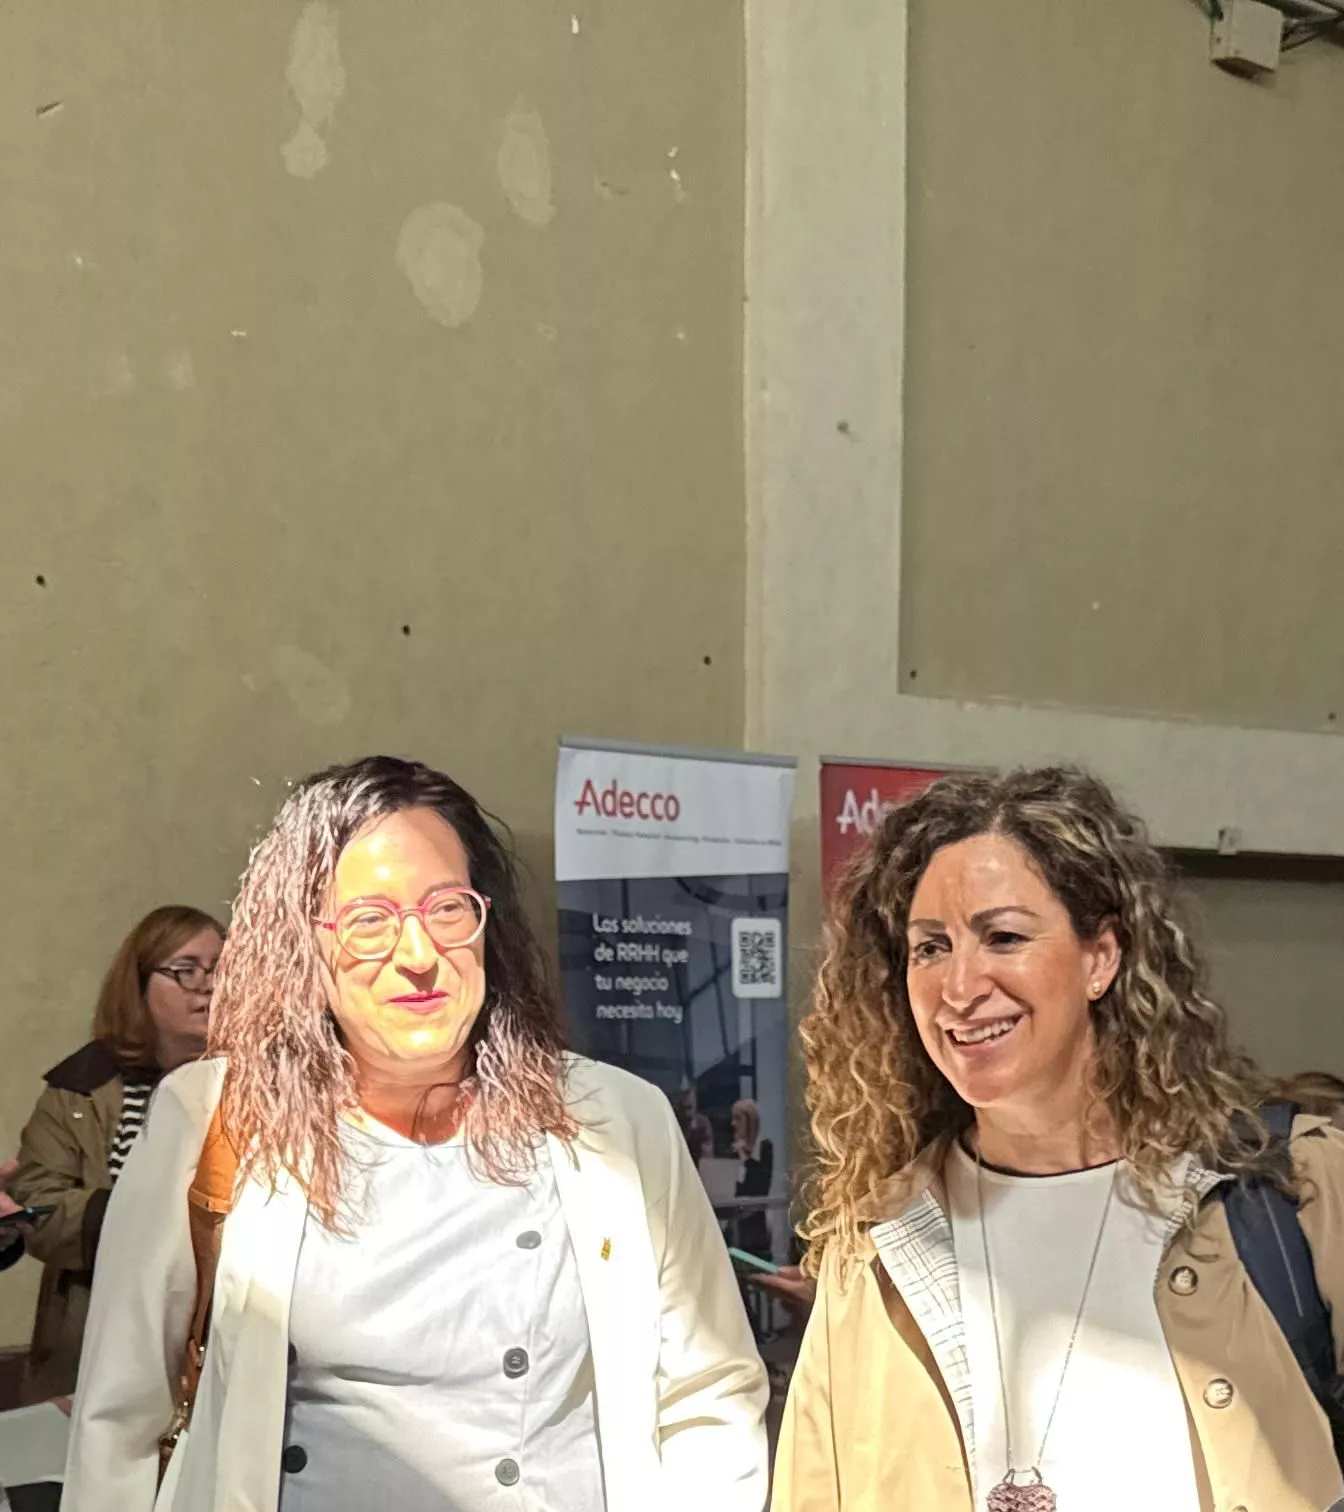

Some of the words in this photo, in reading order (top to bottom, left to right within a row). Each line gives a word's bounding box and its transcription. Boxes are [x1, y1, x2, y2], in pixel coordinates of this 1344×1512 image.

[574, 779, 680, 822] Adecco
[592, 911, 619, 934] Las
[621, 914, 692, 936] soluciones
[594, 942, 615, 962] de
[617, 942, 660, 962] RRHH
[662, 949, 689, 968] que
[594, 974, 613, 991] tu
[615, 971, 669, 995] negocio
[596, 1000, 654, 1019] necesita
[656, 1000, 683, 1024] hoy
